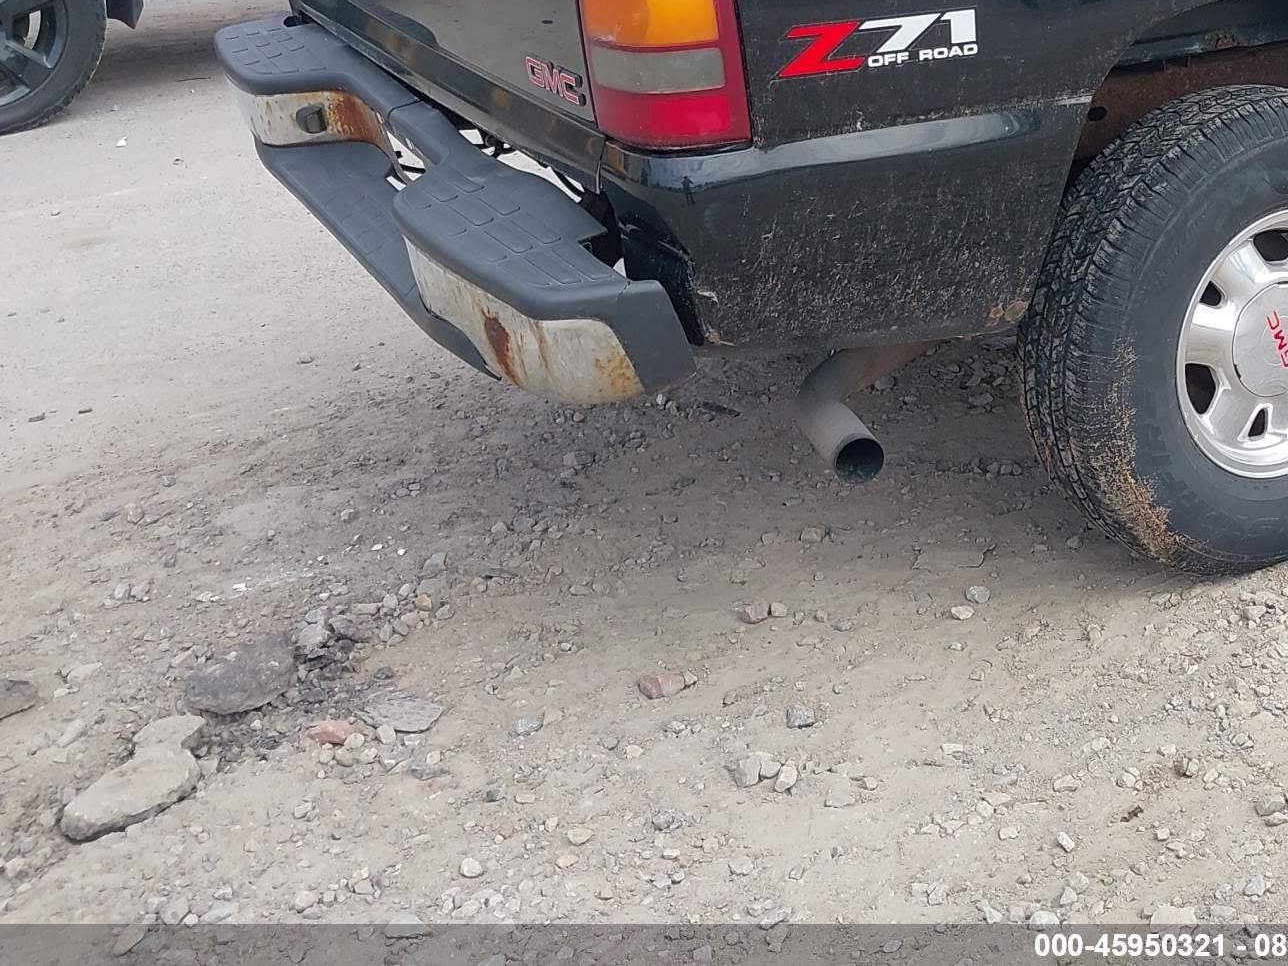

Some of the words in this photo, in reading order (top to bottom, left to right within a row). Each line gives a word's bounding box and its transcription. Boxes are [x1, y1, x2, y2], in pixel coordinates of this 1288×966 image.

[778, 8, 977, 78] Z71
[867, 52, 909, 68] OFF
[918, 43, 979, 62] ROAD
[525, 55, 580, 105] GMC
